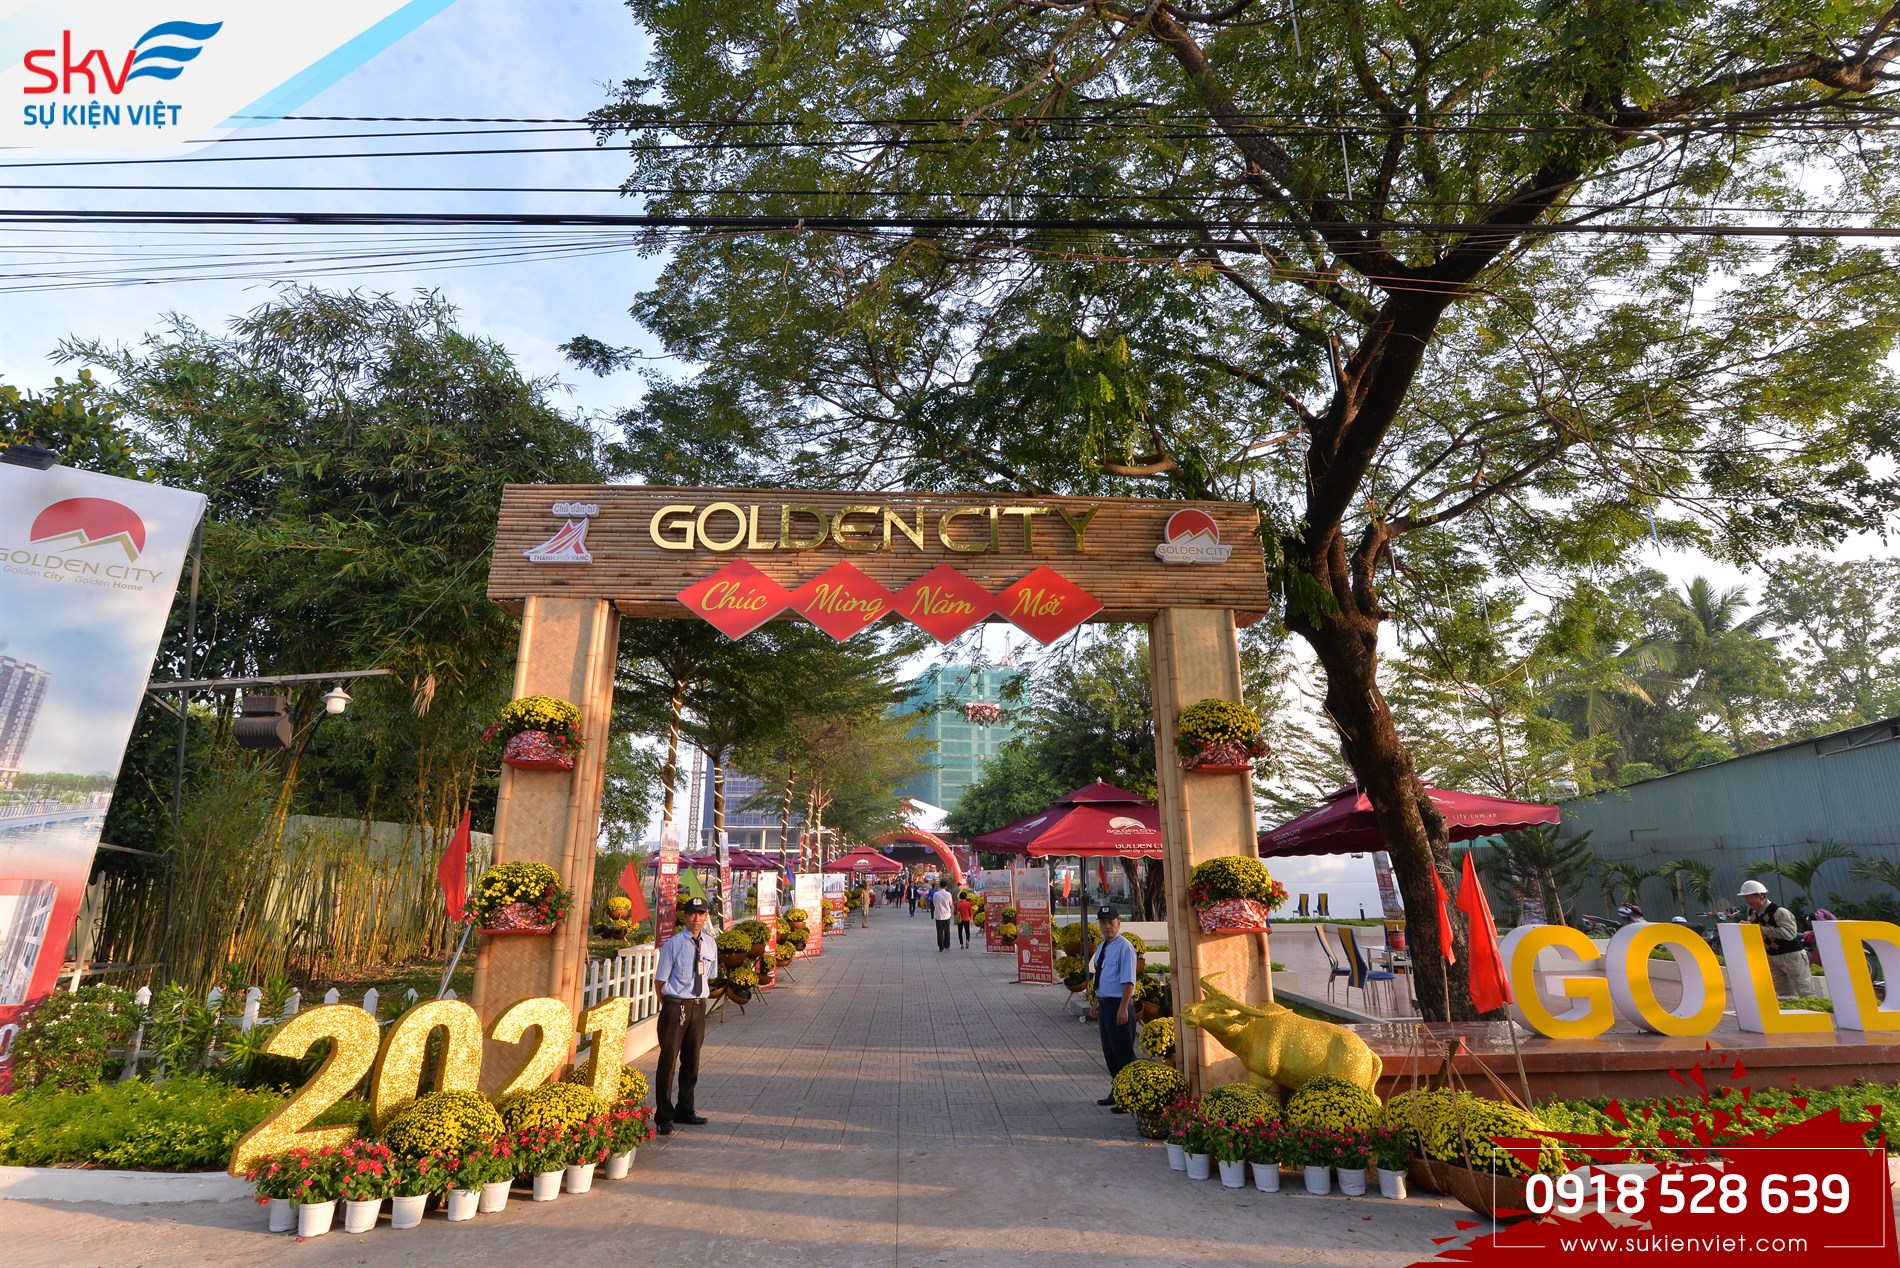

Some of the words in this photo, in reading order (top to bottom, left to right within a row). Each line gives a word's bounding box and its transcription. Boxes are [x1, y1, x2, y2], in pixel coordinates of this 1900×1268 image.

[649, 501, 925, 552] GOLDEN
[938, 505, 1100, 552] CITY
[1159, 546, 1203, 555] GOLDEN
[1206, 547, 1231, 555] CITY
[3, 565, 41, 577] Golden
[43, 571, 65, 581] City
[74, 576, 110, 587] Golden
[112, 581, 144, 592] Home
[105, 565, 163, 584] CITY
[701, 580, 768, 612] Chúc
[804, 583, 885, 621] Mừng
[909, 585, 976, 615] Năm
[1009, 587, 1066, 617] Mới
[227, 996, 633, 1177] 2021
